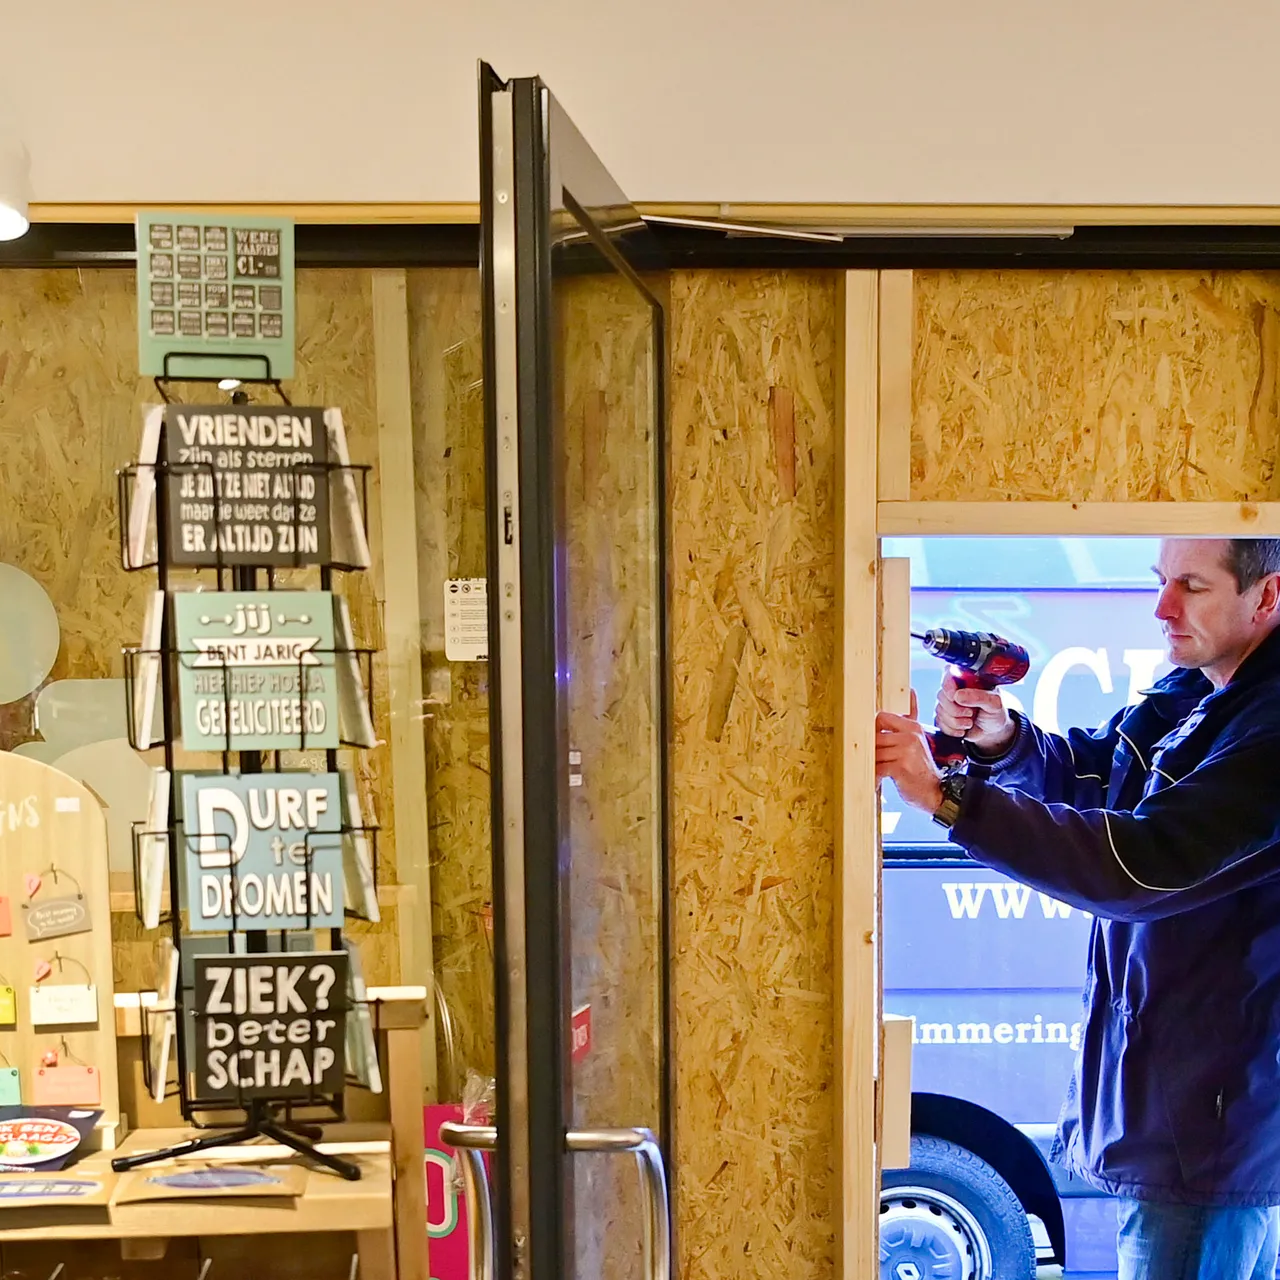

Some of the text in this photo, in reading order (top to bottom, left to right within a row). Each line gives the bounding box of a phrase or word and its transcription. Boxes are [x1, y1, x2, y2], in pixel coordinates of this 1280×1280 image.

[235, 231, 278, 244] WENS
[237, 243, 279, 256] KAARTEN
[177, 414, 313, 447] VRIENDEN
[179, 448, 314, 469] zijn als sterren
[180, 473, 270, 498] JE ZE NIET
[180, 501, 316, 522] maar je weet ze
[182, 524, 318, 553] ER ALTIJD ZIJN
[232, 603, 272, 635] jij
[207, 644, 246, 661] BENT
[232, 673, 265, 694] HIEP
[198, 788, 328, 869] DURF
[271, 835, 313, 866] te
[201, 871, 332, 918] DROMEN
[205, 964, 336, 1015] ZIEK?
[207, 1017, 336, 1048] beter
[207, 1048, 335, 1089] SCHAP
[21, 1124, 58, 1133] BEN
